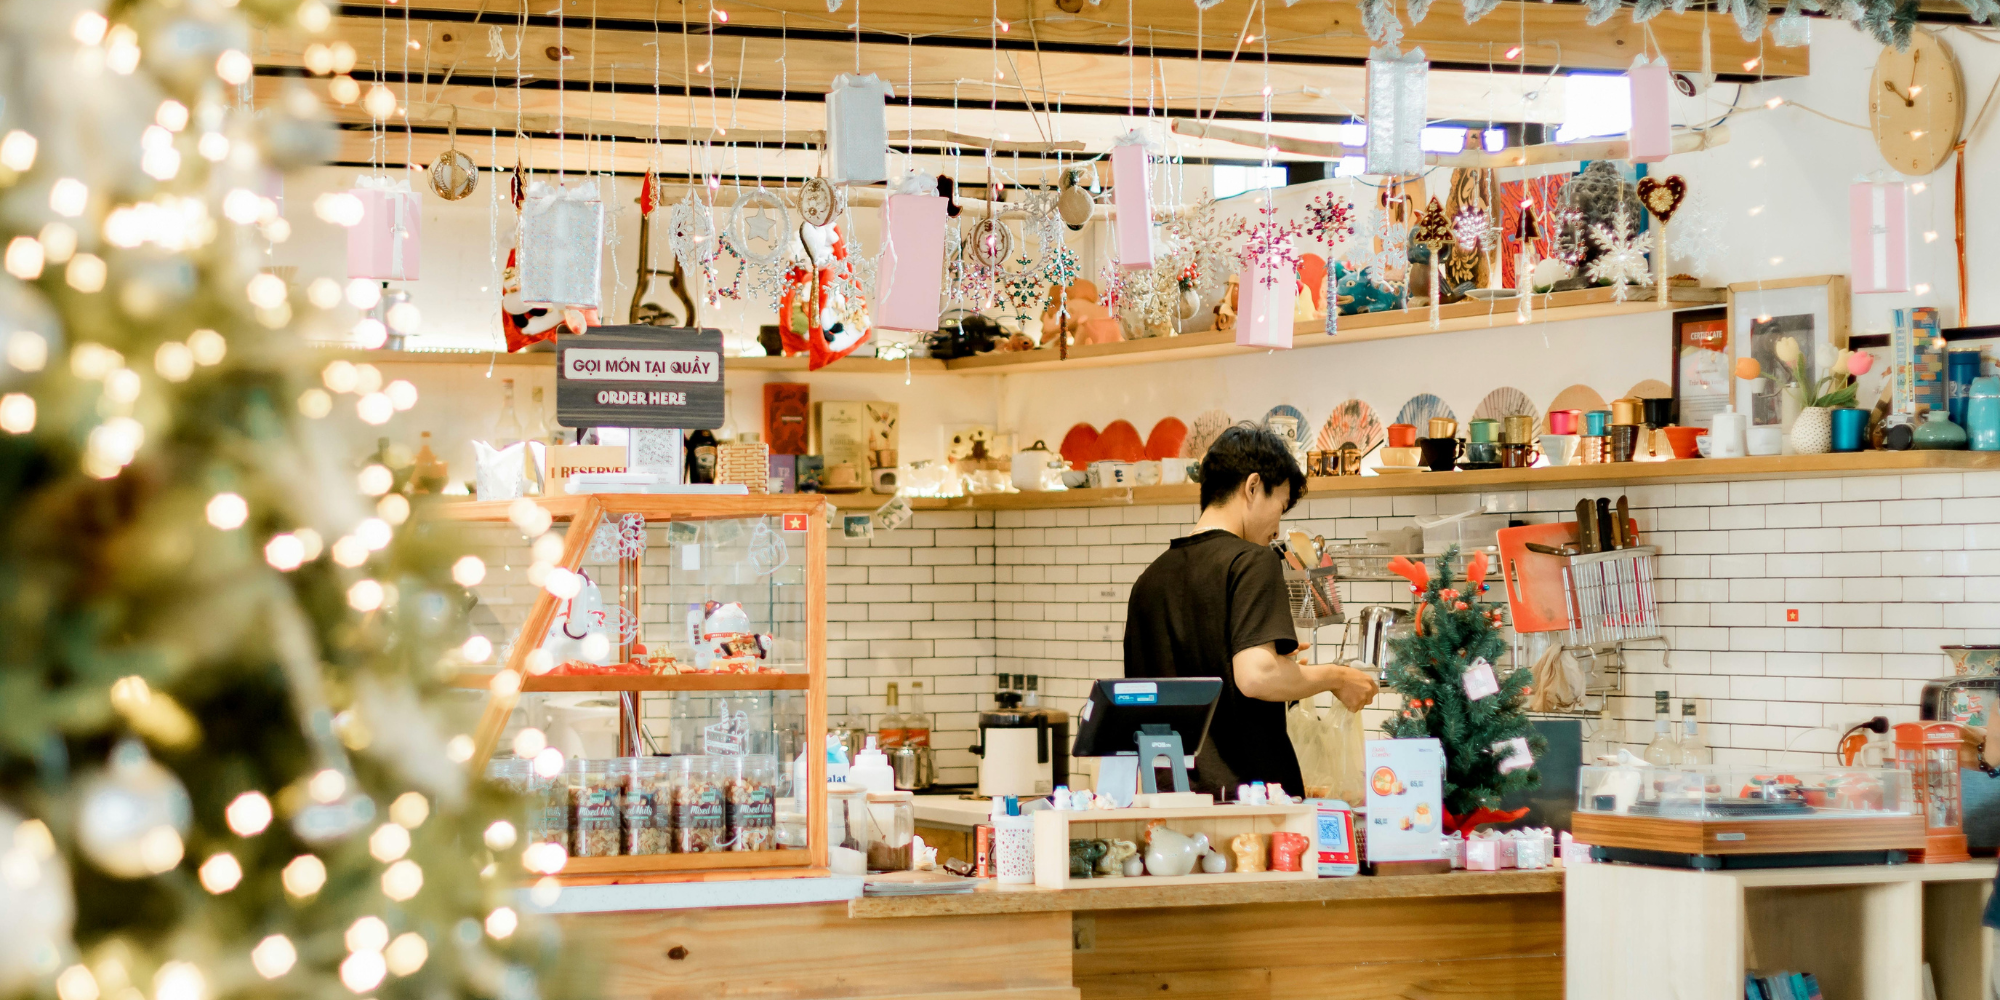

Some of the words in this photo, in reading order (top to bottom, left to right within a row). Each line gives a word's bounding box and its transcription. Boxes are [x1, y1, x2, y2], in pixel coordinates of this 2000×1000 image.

[1947, 92, 1953, 102] 3
[1871, 103, 1878, 113] 9
[1912, 159, 1918, 169] 6
[573, 359, 600, 376] GỌI
[605, 357, 640, 373] MÓN
[644, 361, 666, 377] TẠI
[670, 356, 711, 374] QUẦY
[597, 390, 647, 405] ORDER
[649, 391, 687, 406] HERE
[561, 466, 627, 478] RESERVE
[826, 774, 846, 783] alat
[601, 806, 615, 817] Nuts
[690, 804, 711, 815] Mixed
[740, 803, 761, 814] Mixed
